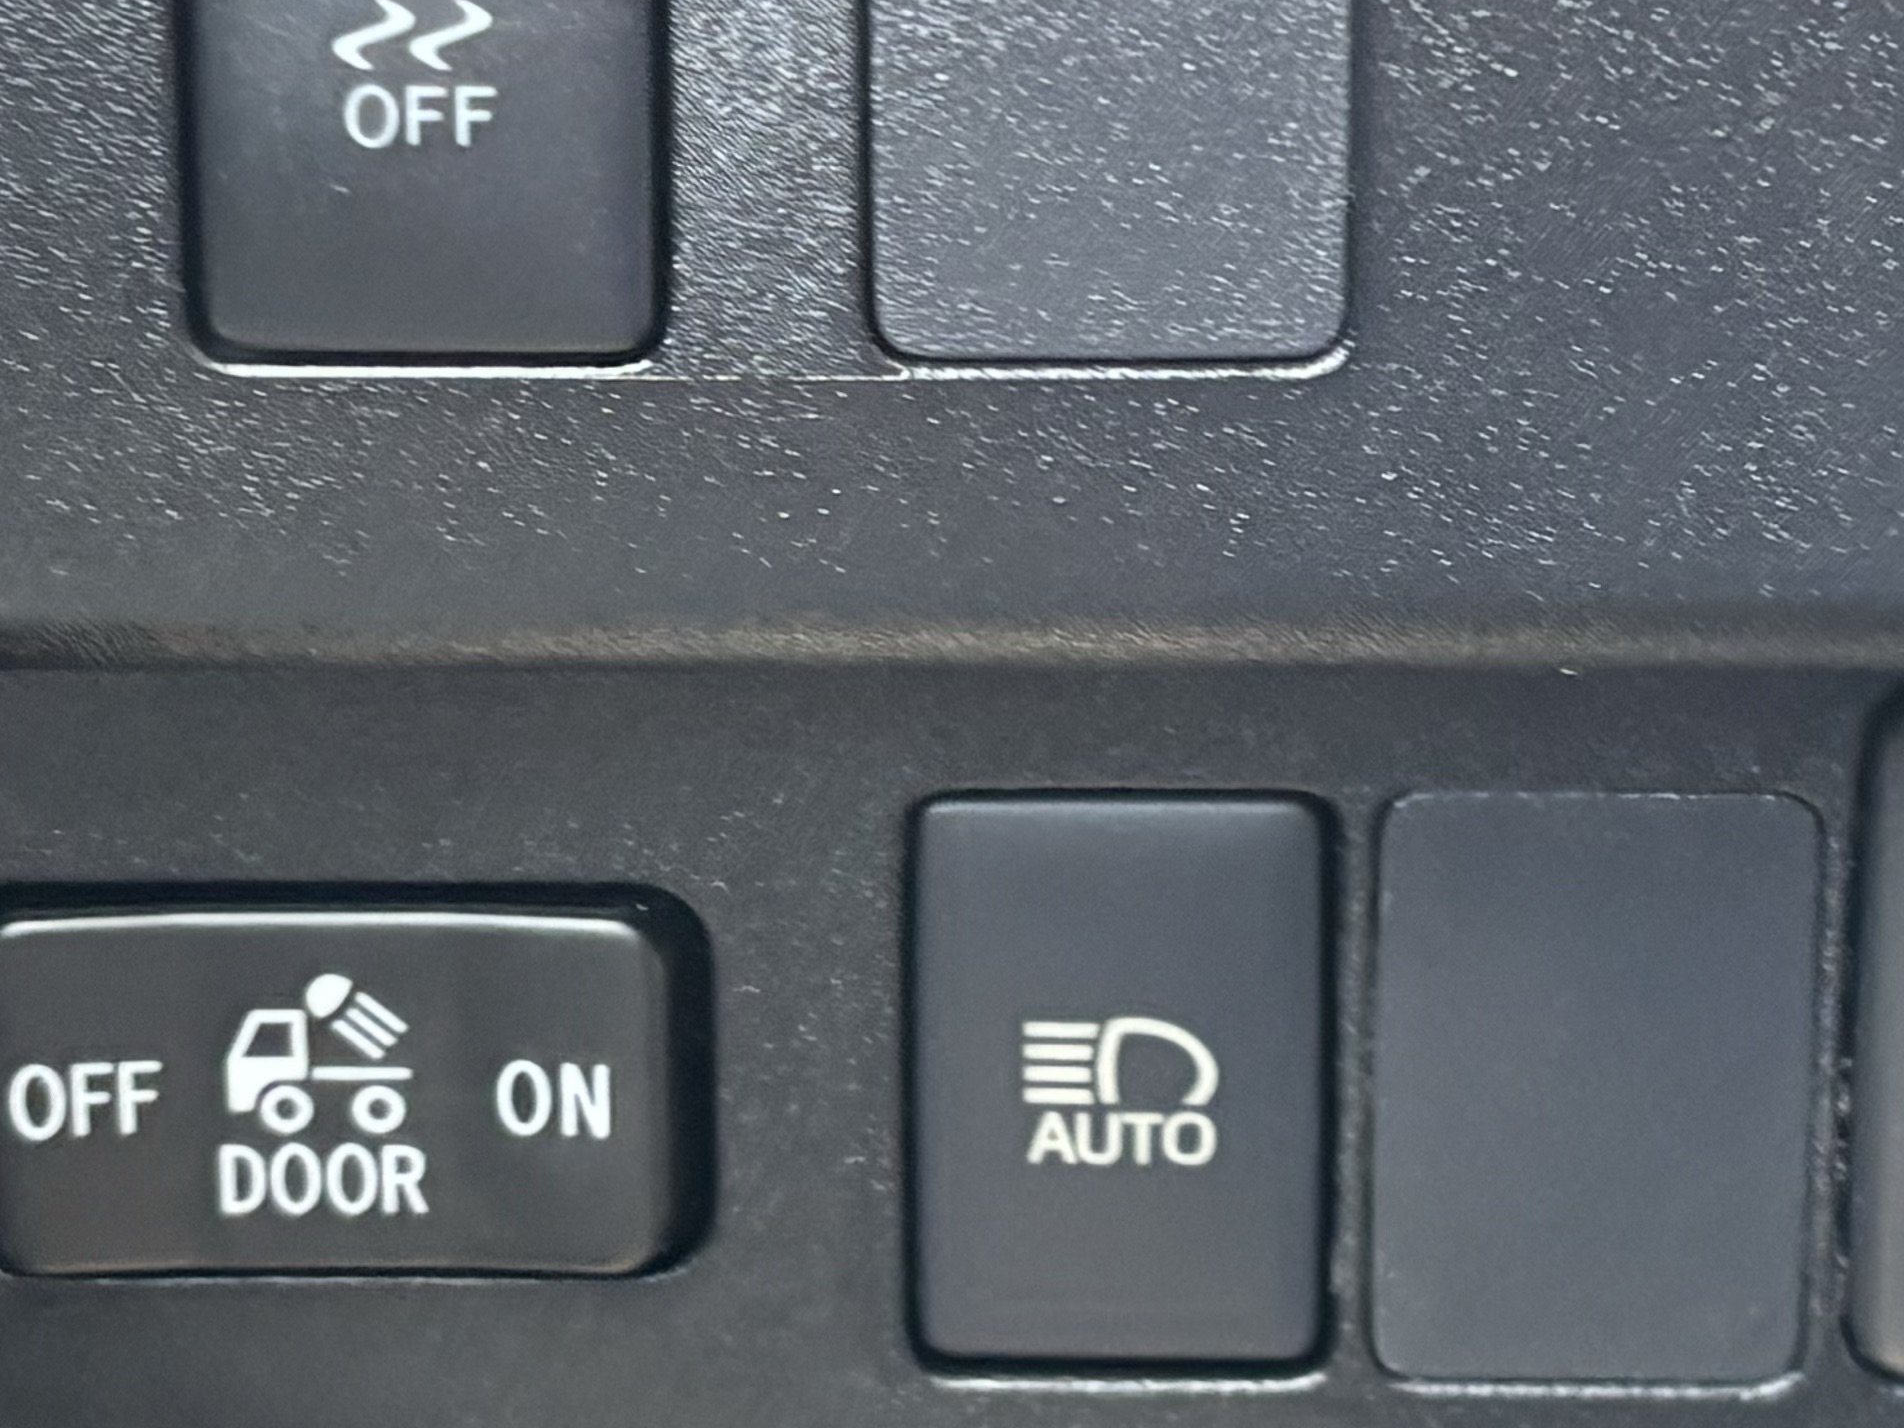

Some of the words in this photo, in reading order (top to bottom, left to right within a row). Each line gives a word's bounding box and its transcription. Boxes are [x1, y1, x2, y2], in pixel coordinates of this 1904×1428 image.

[342, 82, 498, 150] OFF
[7, 1059, 164, 1142] OFF
[495, 1058, 612, 1142] ON
[1026, 1110, 1218, 1167] AUTO
[217, 1140, 430, 1218] DOOR
